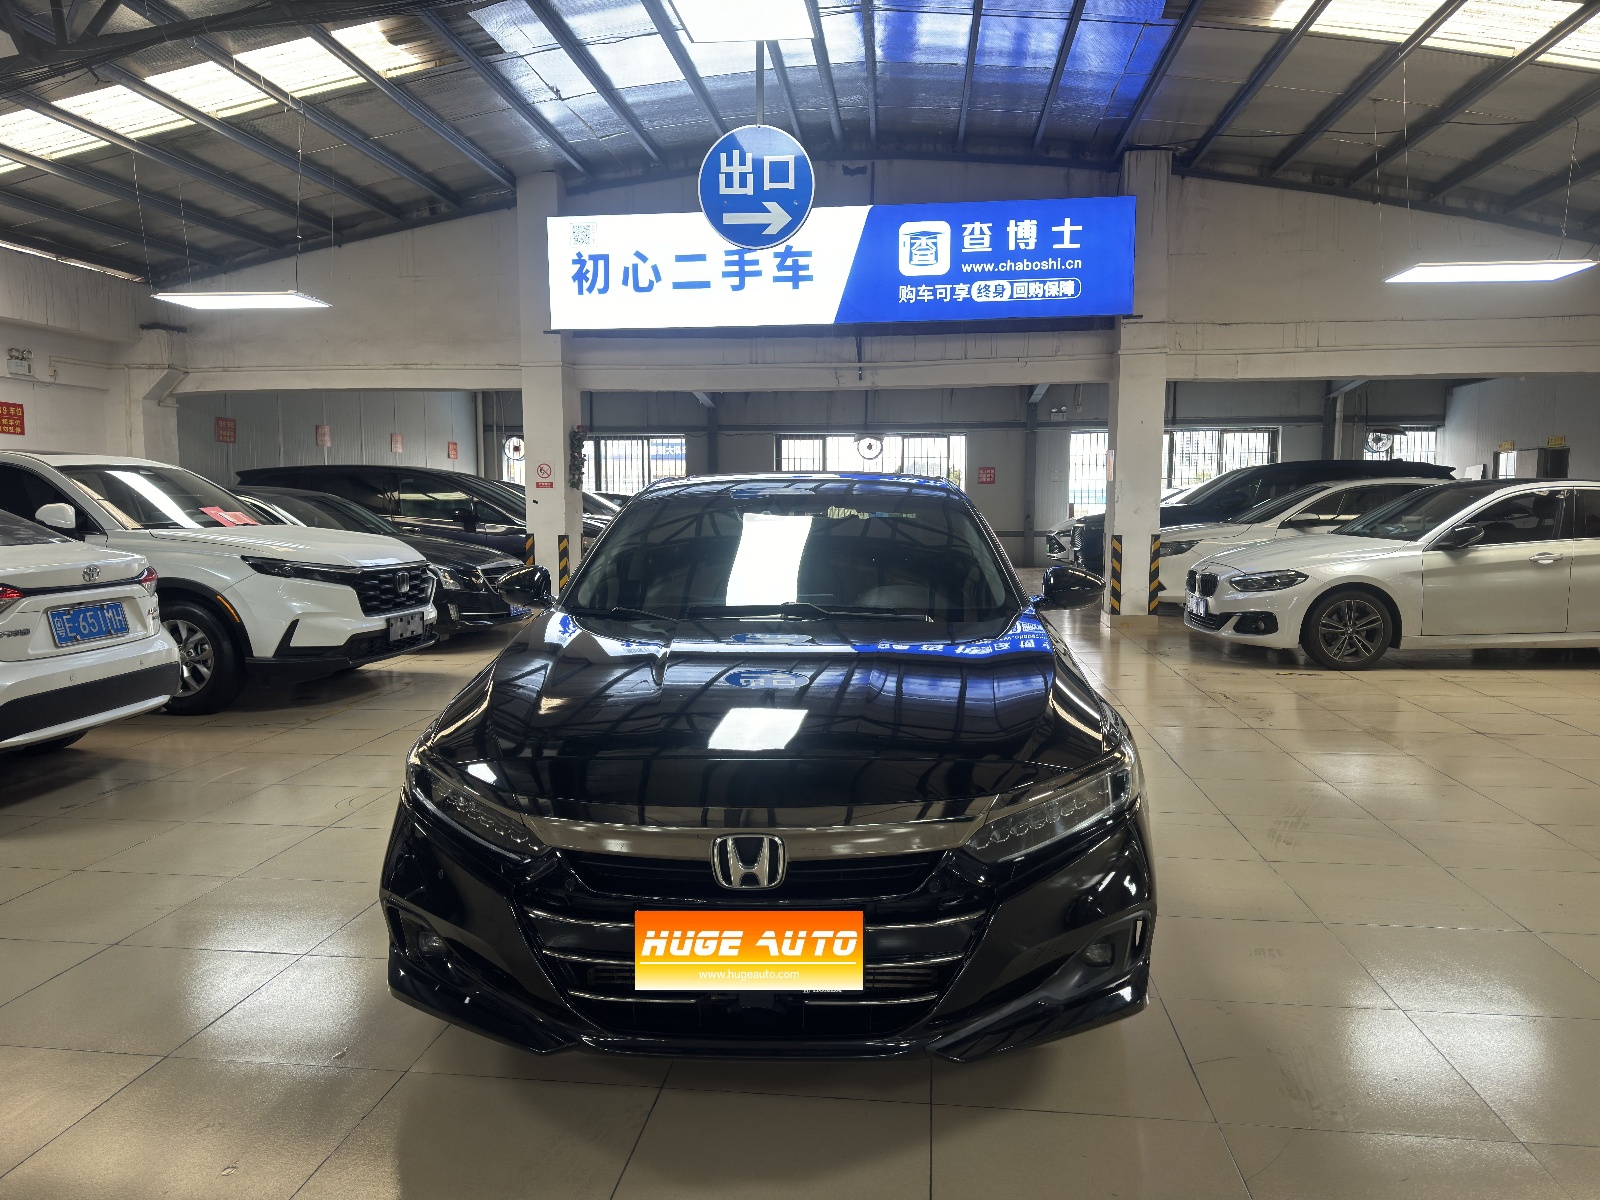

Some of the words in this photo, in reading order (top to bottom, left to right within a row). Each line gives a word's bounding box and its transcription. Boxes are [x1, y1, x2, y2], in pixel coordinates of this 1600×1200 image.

[719, 150, 795, 195] 出口
[961, 217, 1083, 253] 查博士
[571, 245, 814, 295] 初心二手车
[961, 258, 1083, 273] www.chaboshi.cn
